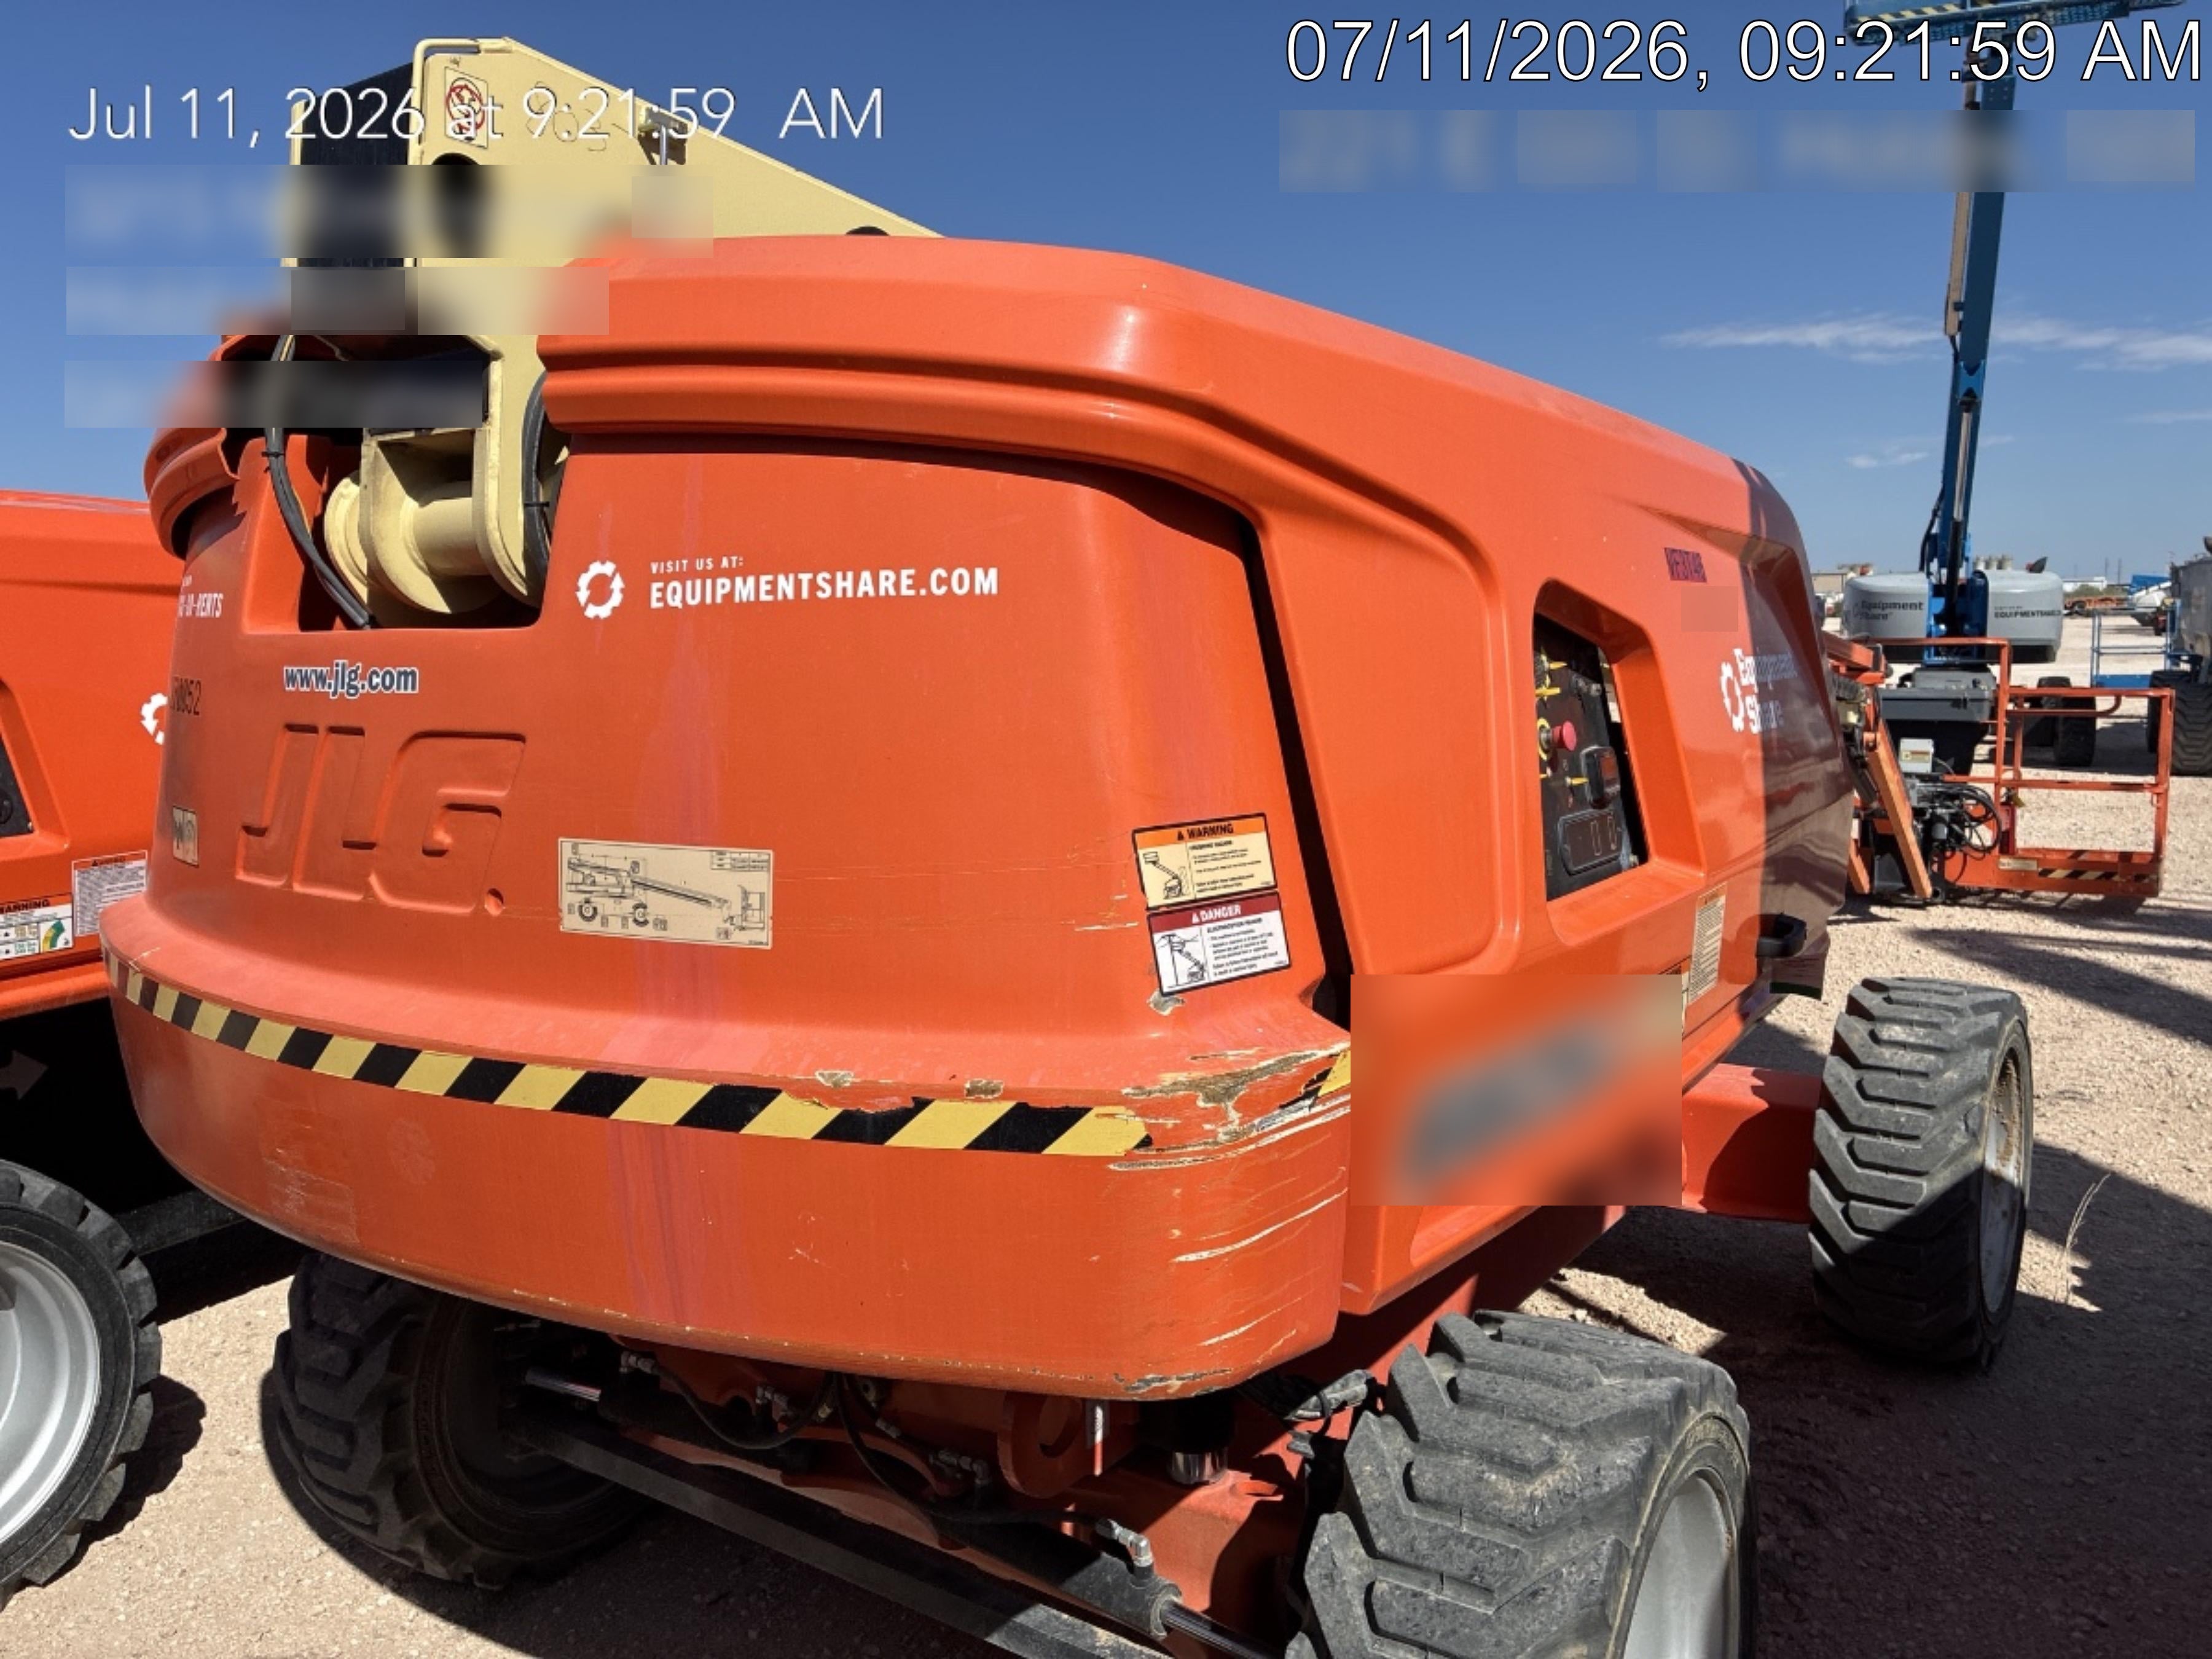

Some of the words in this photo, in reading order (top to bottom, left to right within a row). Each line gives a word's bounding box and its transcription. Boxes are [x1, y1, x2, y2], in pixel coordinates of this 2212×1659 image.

[650, 560, 688, 574] VISIT
[696, 558, 713, 570] US
[720, 555, 743, 568] AT:
[650, 567, 998, 609] EQUIPMENTSHARE.COM
[283, 659, 419, 699] www.jlg.com
[235, 723, 527, 916] JLG
[1187, 823, 1234, 839] WARNING
[1200, 904, 1241, 922] DANGER
